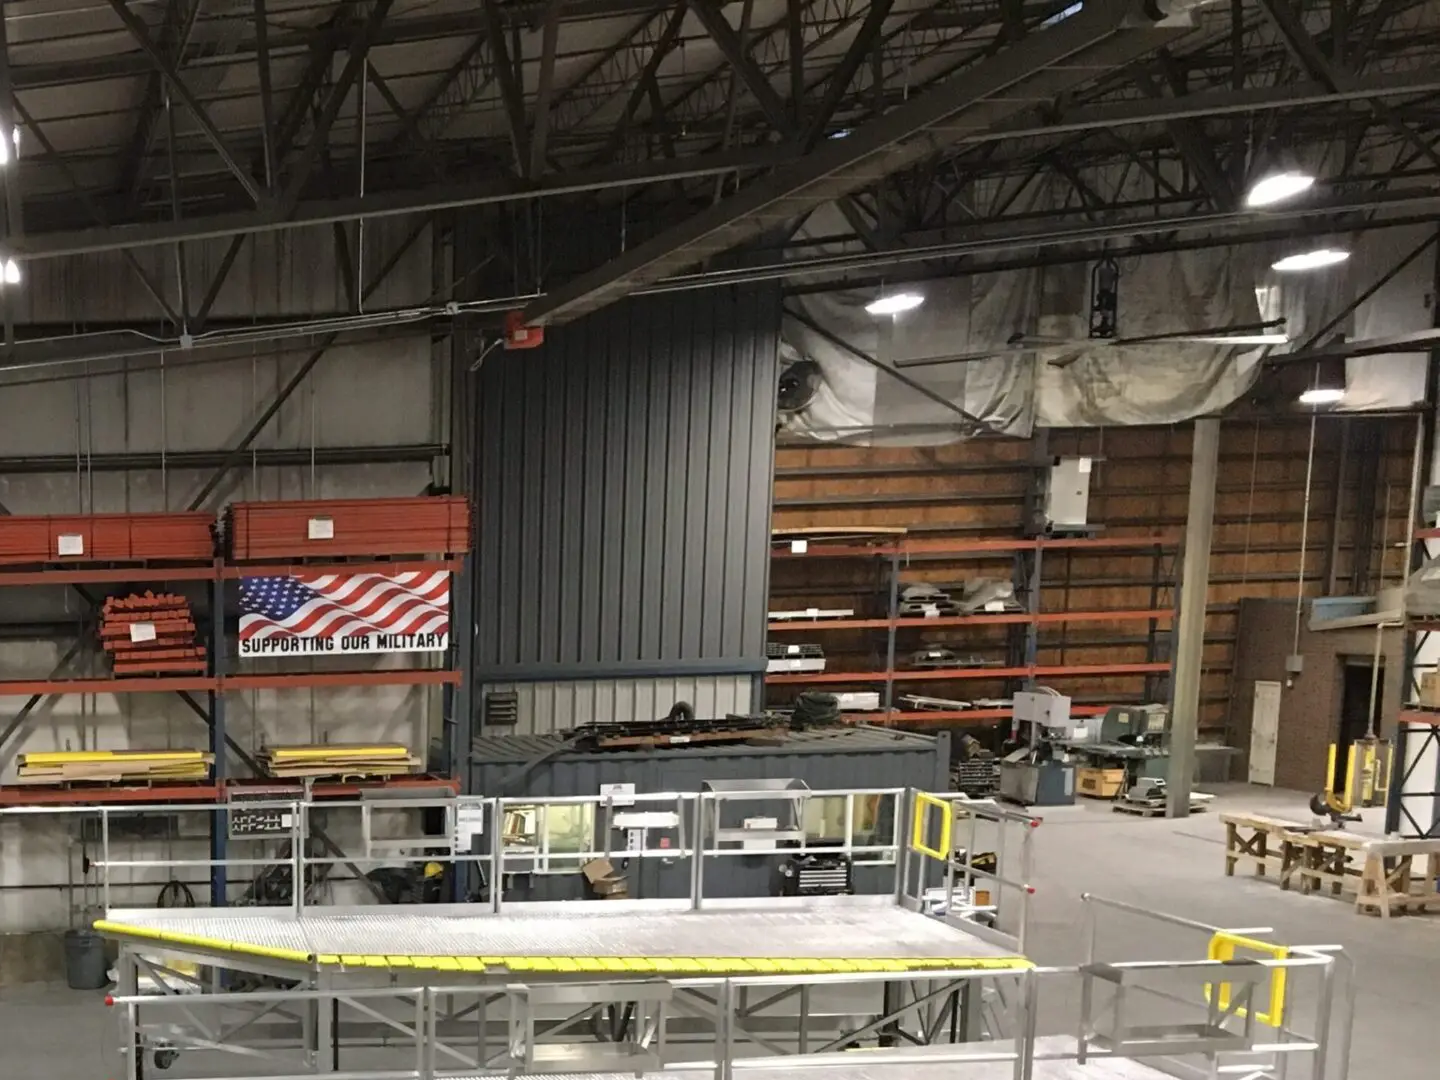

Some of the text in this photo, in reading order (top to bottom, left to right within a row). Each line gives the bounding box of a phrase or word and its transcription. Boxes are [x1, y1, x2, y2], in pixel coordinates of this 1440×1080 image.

[242, 632, 445, 653] SUPPORTING OUR MILITARY
